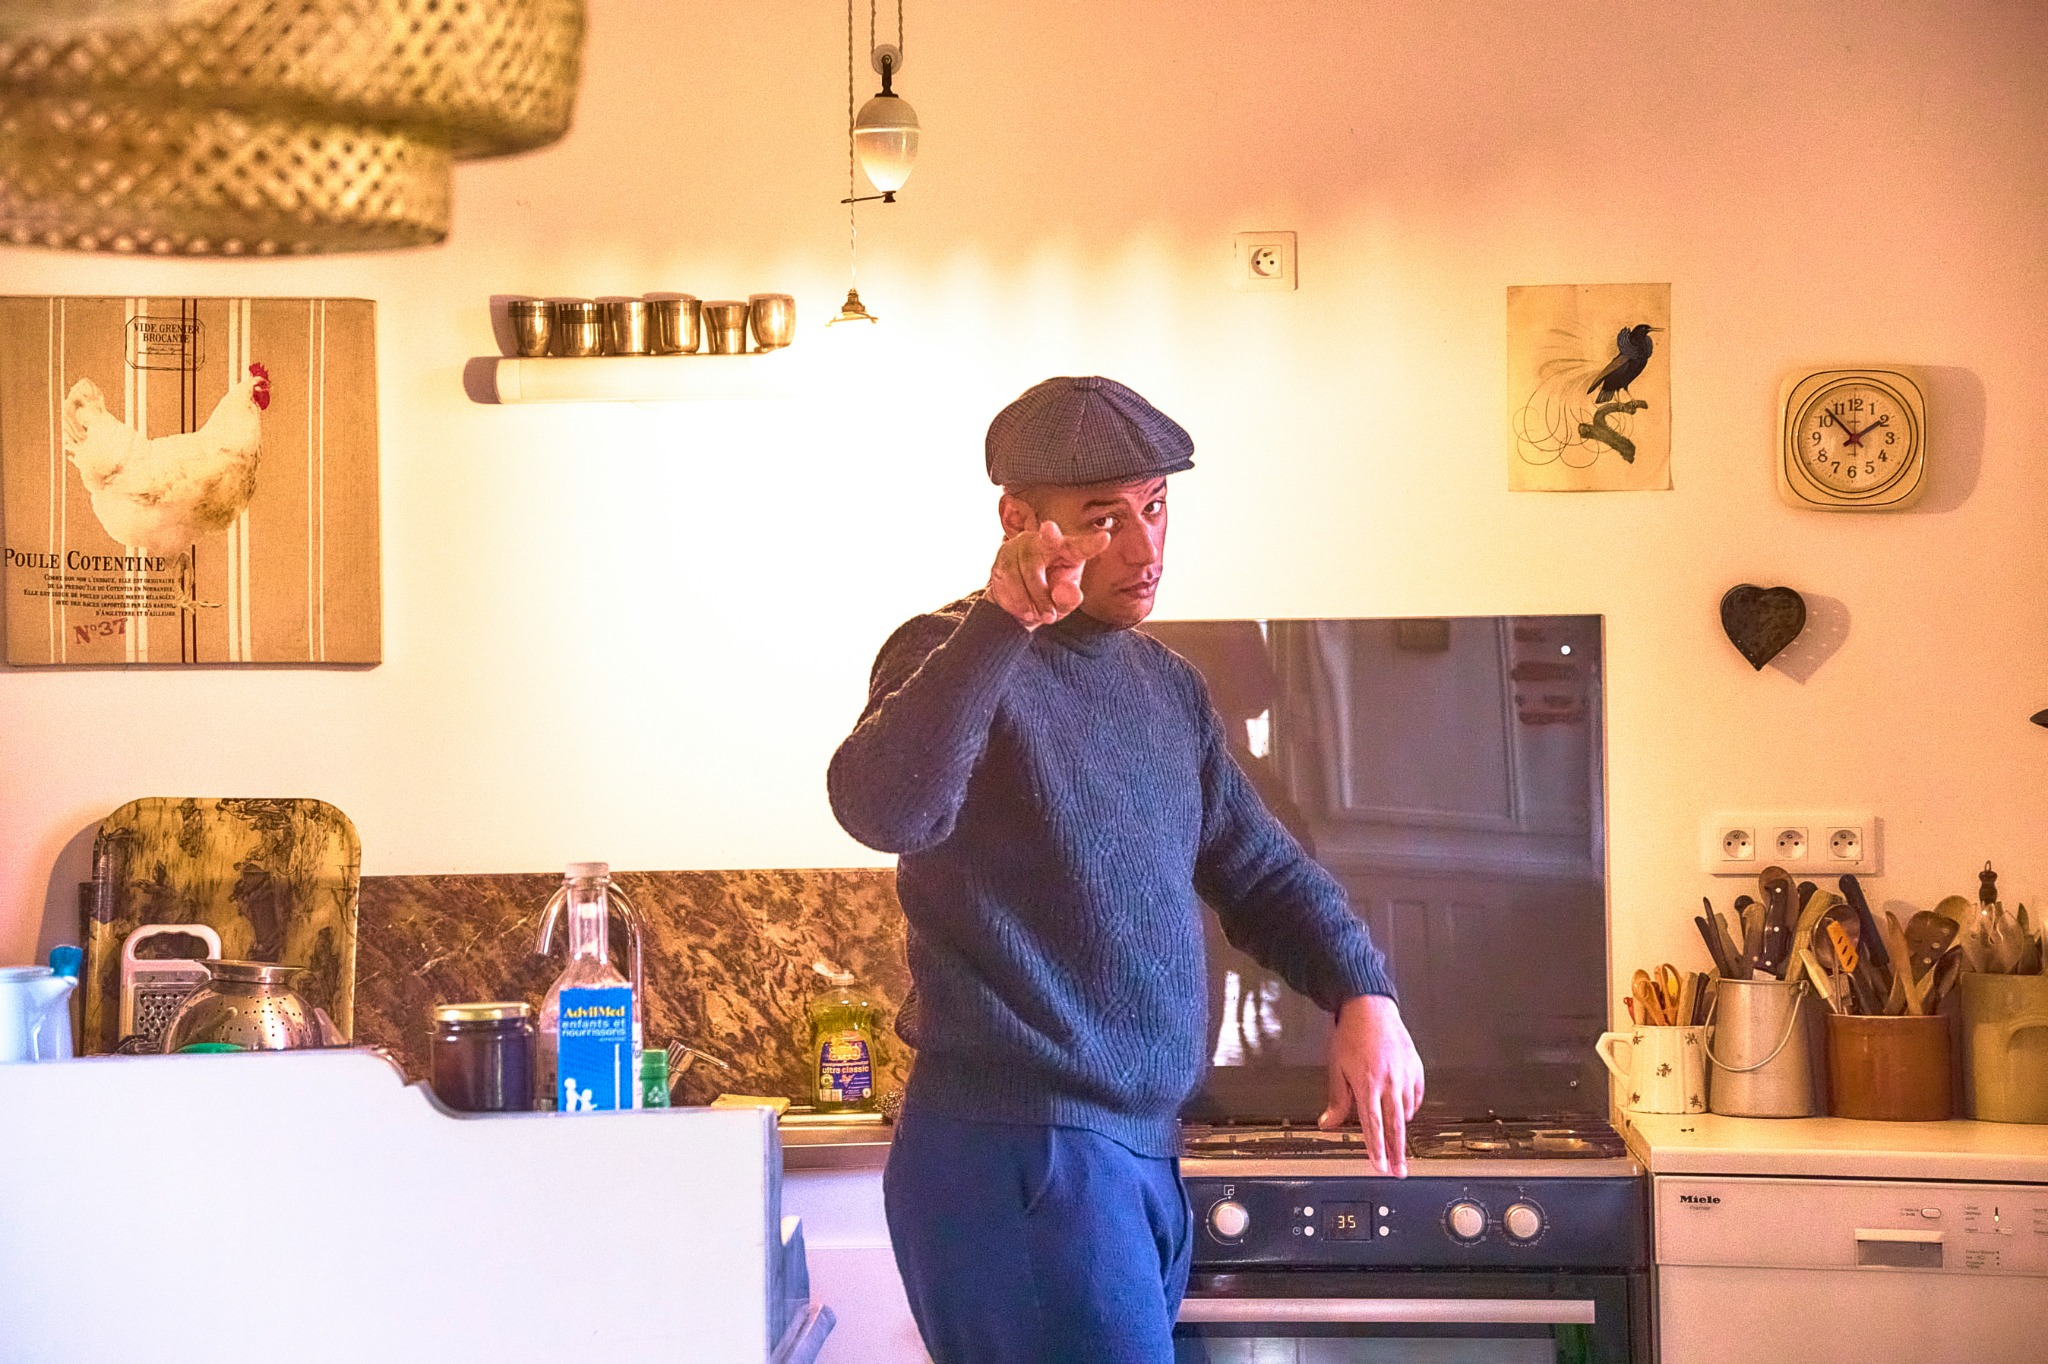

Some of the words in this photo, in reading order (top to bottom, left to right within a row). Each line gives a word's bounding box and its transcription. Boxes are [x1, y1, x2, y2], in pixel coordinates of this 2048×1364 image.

[134, 323, 158, 332] VIDE
[159, 323, 200, 334] GRENIER
[143, 333, 190, 343] BROCANTE
[1833, 402, 1845, 415] 11
[1848, 398, 1863, 412] 12
[1869, 402, 1875, 415] 1
[1819, 415, 1833, 428] 10
[1880, 414, 1889, 427] 2
[1812, 431, 1822, 446] 9
[1885, 432, 1895, 445] 3
[1817, 449, 1828, 463] 8
[1878, 449, 1888, 462] 4
[1831, 461, 1840, 474] 7
[1847, 465, 1857, 479] 6
[1865, 461, 1875, 474] 5
[562, 1019, 609, 1028] enfants
[613, 1018, 626, 1028] et
[1680, 1194, 1721, 1204] Miele
[1337, 1214, 1356, 1229] 35
